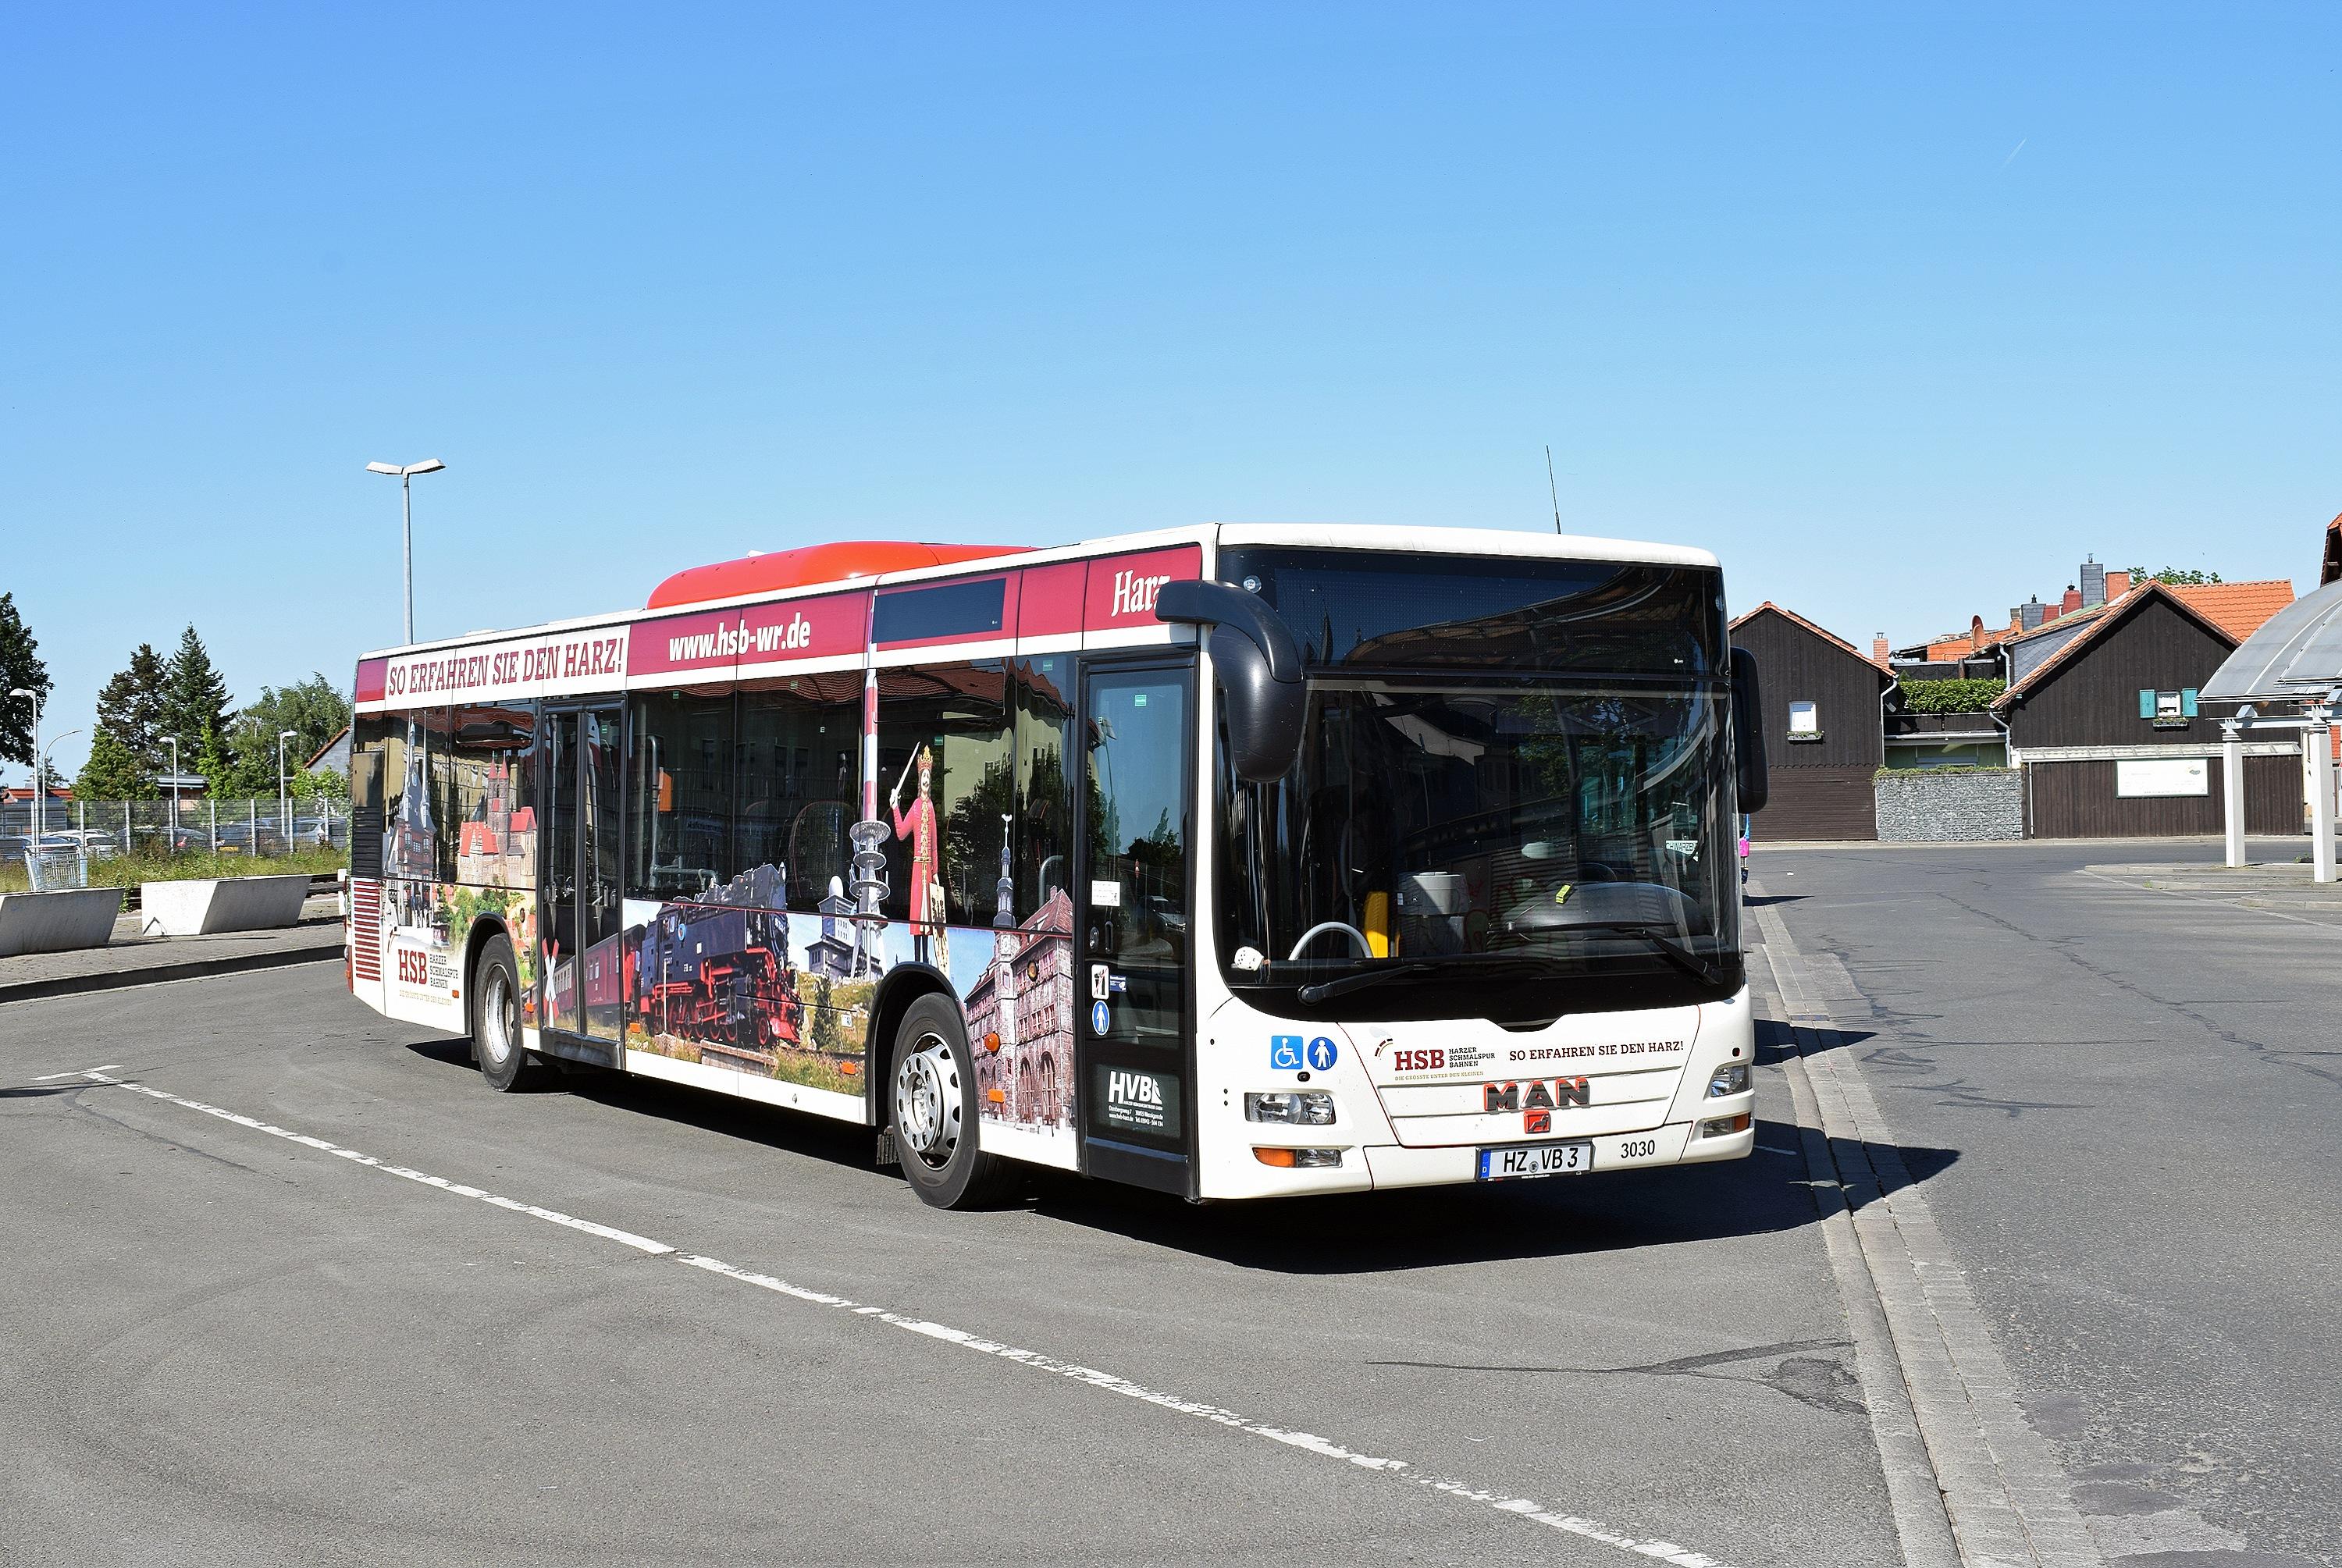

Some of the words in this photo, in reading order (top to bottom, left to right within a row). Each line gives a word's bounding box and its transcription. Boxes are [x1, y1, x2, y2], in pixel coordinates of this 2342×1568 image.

[669, 612, 811, 662] www.hsb-wr.de
[389, 666, 406, 695] SO
[409, 655, 489, 693] ERFAHREN
[493, 651, 519, 685] SIE
[522, 645, 561, 681] DEN
[564, 638, 624, 677] HARZ!
[398, 949, 427, 985] HSB
[1394, 1049, 1445, 1071] HSB
[1449, 1053, 1496, 1061] SCHMALSPUR
[1509, 1051, 1525, 1061] SO
[1529, 1046, 1595, 1060] ERFAHREN
[1599, 1044, 1618, 1055] SIE
[1621, 1043, 1645, 1054] DEN
[1648, 1041, 1684, 1052] HARZ!
[1109, 1070, 1153, 1104] HVB
[1483, 1076, 1590, 1113] MAN
[1504, 1150, 1528, 1172] HZ
[1541, 1149, 1563, 1170] VB
[1567, 1147, 1579, 1168] 3
[1621, 1140, 1656, 1158] 3030
